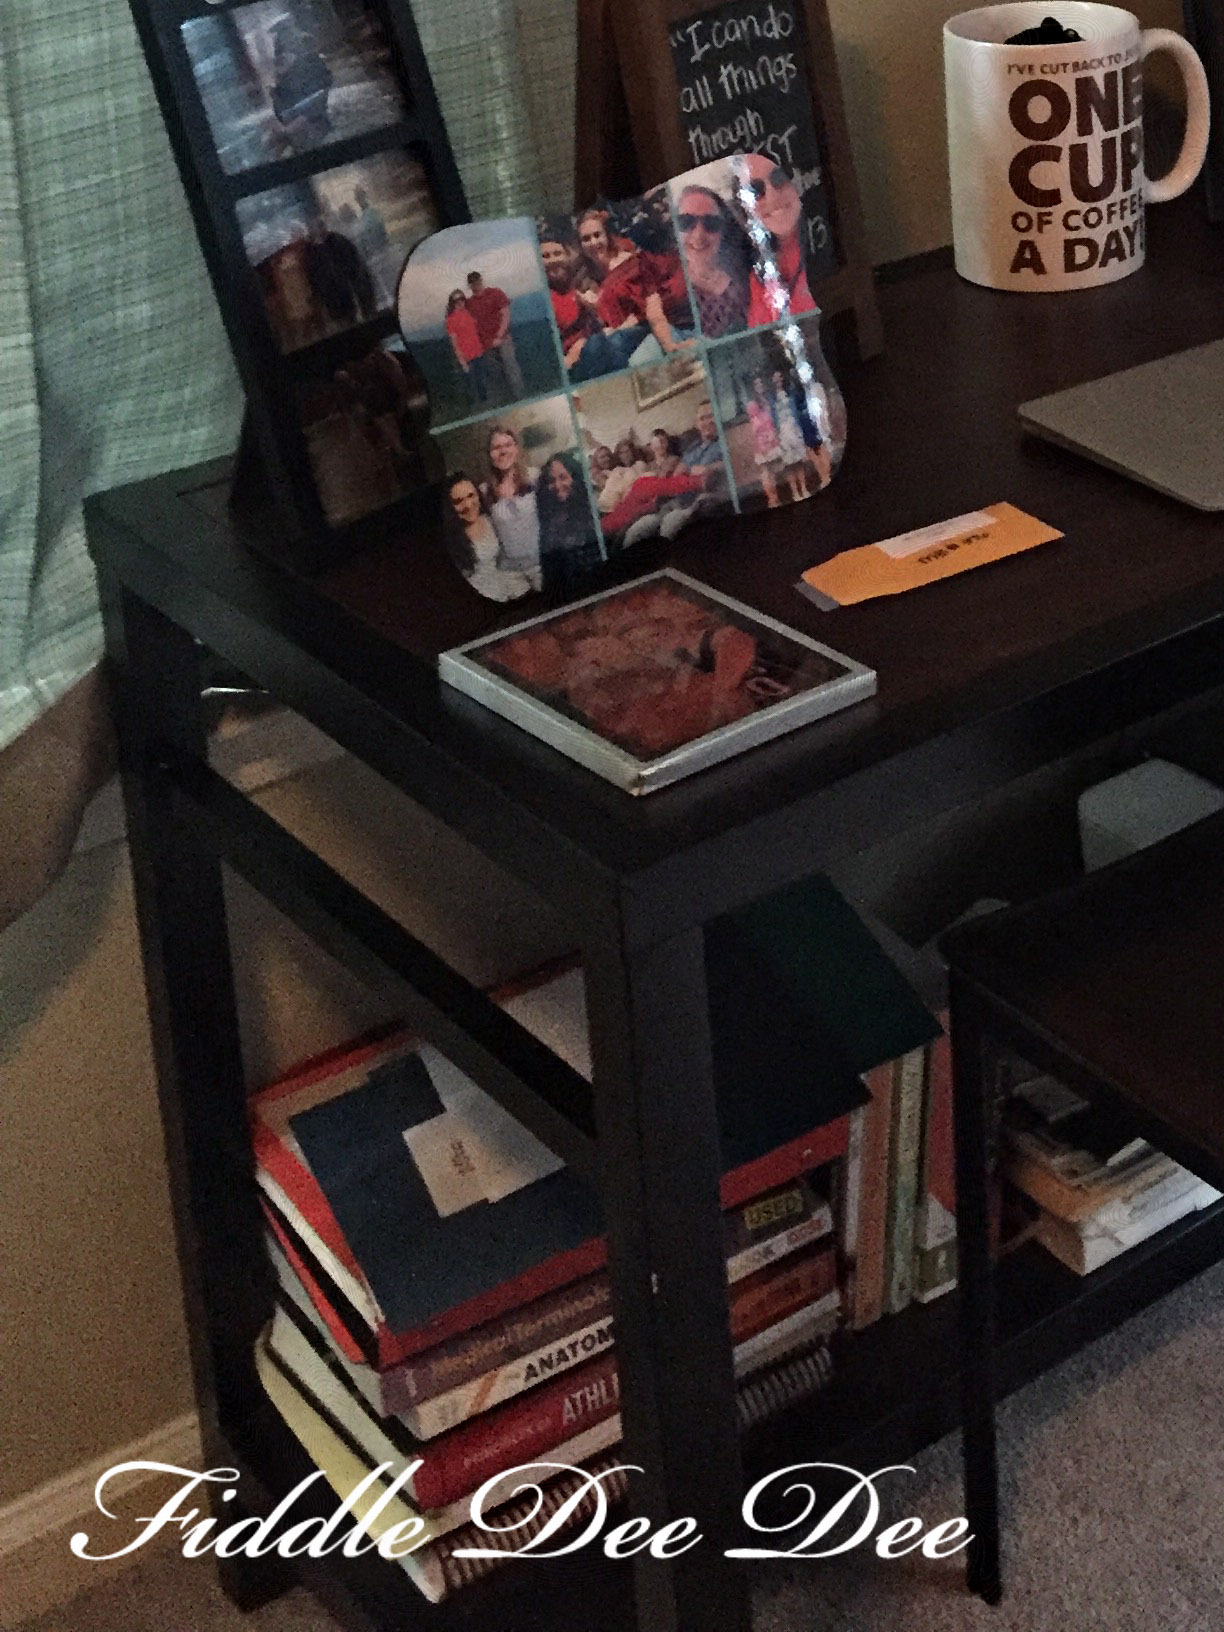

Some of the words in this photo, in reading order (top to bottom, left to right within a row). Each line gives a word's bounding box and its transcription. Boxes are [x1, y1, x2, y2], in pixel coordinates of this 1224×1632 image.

[680, 74, 714, 113] all
[718, 52, 797, 100] things
[1007, 63, 1035, 76] I'VE
[1040, 62, 1070, 75] CUT
[1072, 57, 1105, 73] BACK
[1107, 53, 1122, 66] TO
[1008, 62, 1144, 141] ONE
[1008, 125, 1144, 208] CUP
[1011, 211, 1053, 234] OF
[1009, 239, 1047, 276] A
